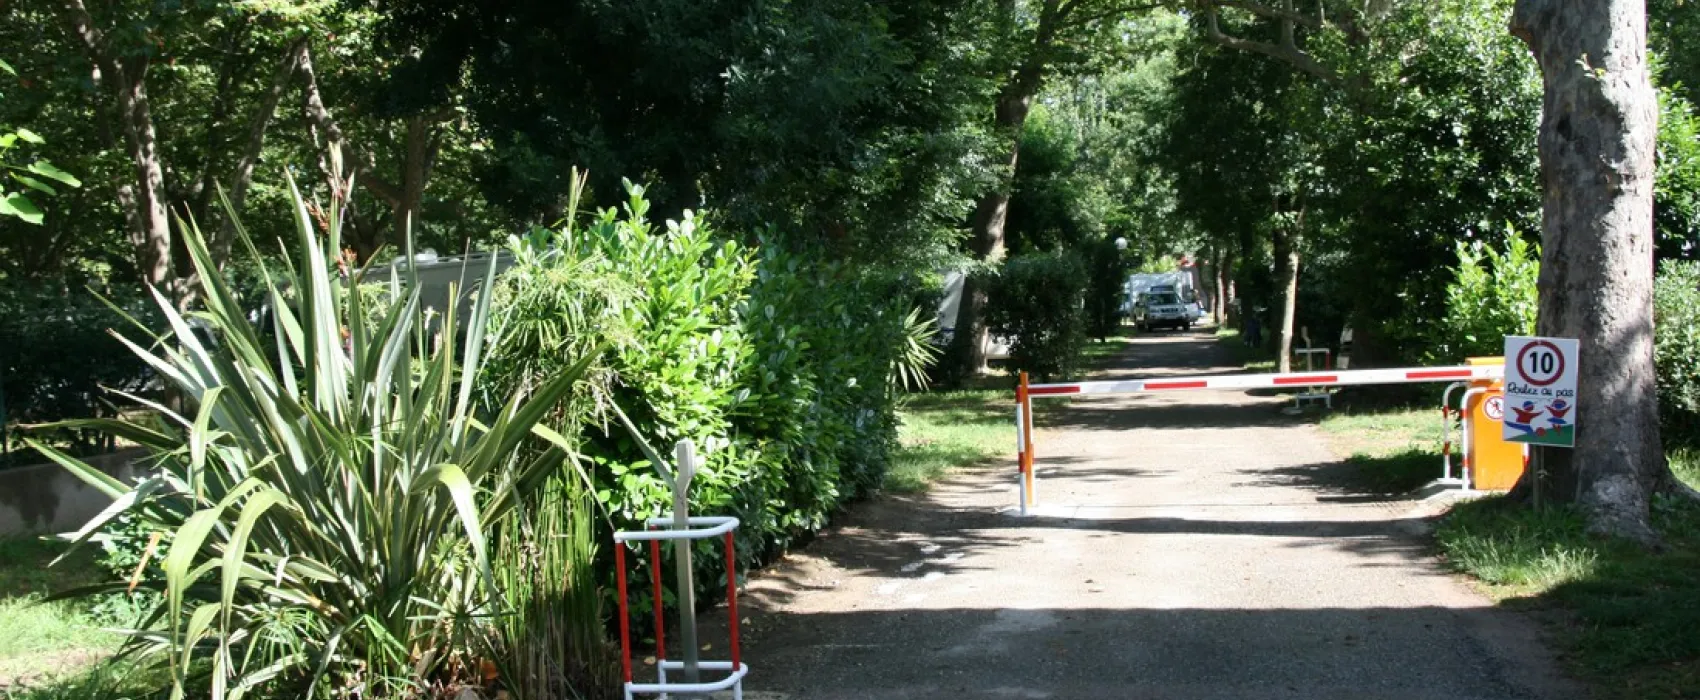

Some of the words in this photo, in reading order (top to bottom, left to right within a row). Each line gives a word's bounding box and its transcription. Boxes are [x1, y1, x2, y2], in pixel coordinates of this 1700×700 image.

[1529, 351, 1554, 374] 10
[1507, 381, 1538, 395] Roulez
[1541, 387, 1553, 396] au
[1556, 388, 1574, 397] pas
